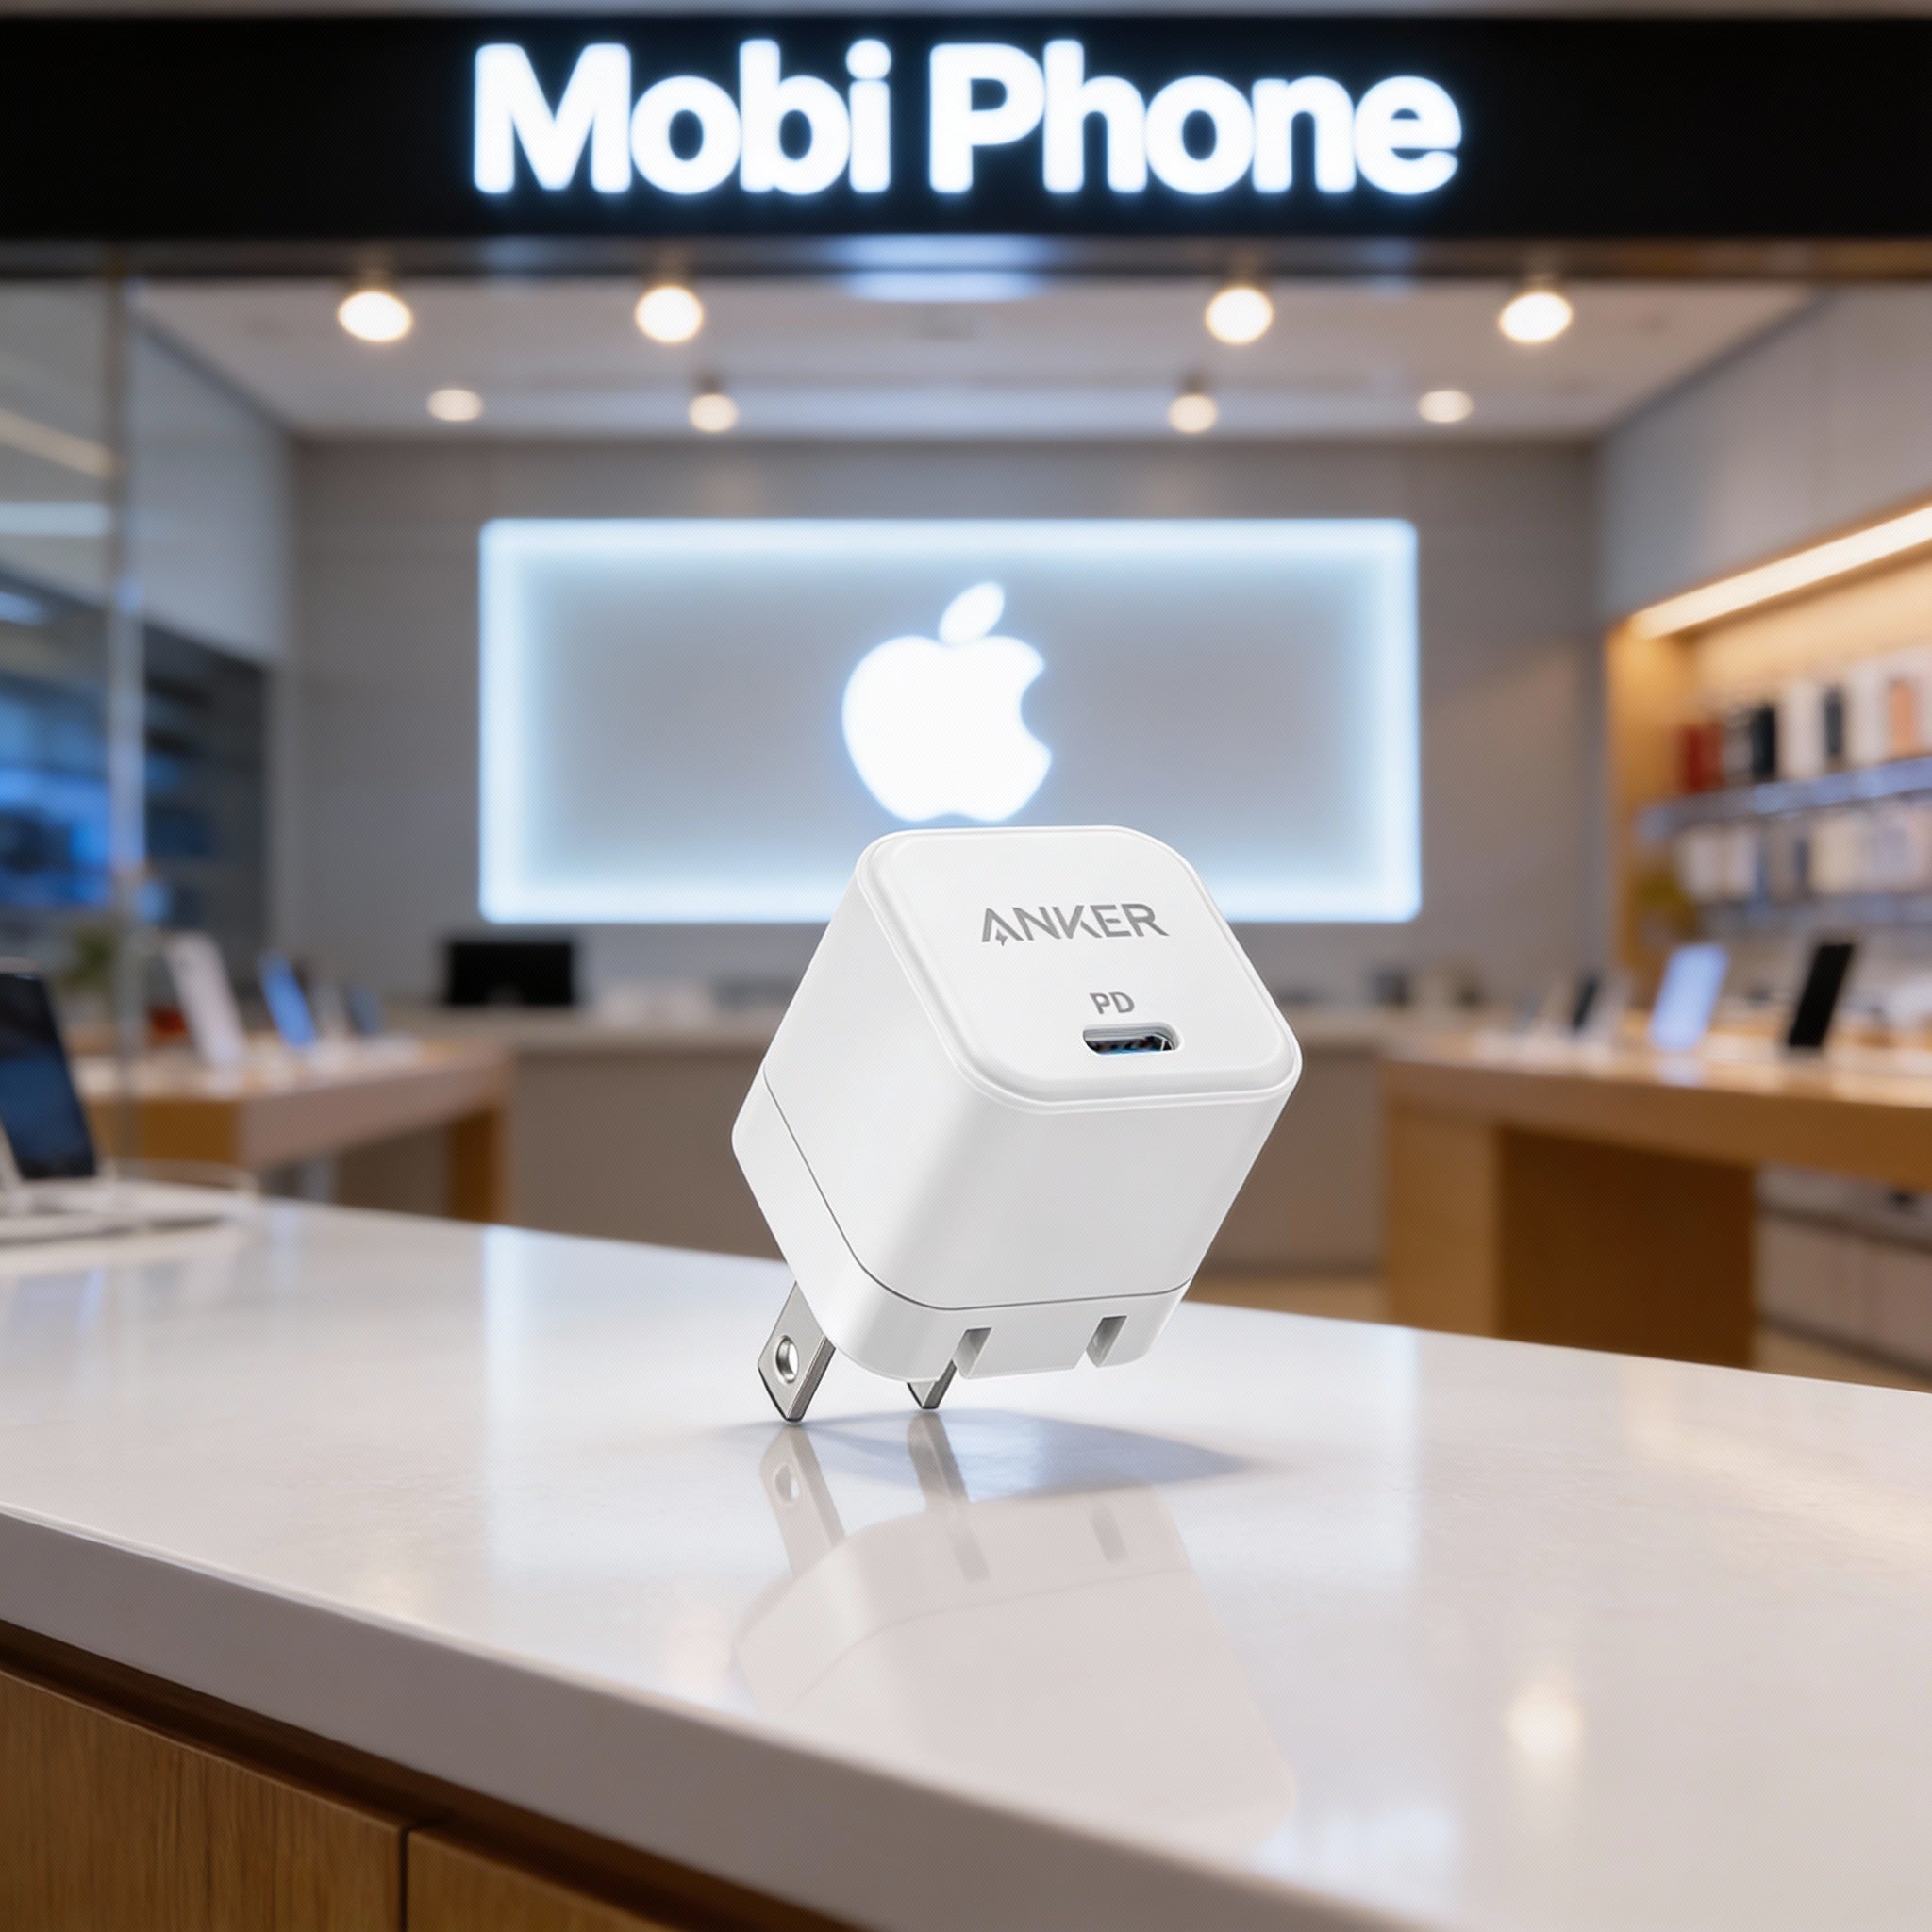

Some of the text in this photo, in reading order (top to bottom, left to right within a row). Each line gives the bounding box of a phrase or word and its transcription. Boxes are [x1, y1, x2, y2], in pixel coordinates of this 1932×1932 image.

[474, 39, 1462, 195] Mobi Phone
[981, 903, 1170, 946] ANKER
[1089, 991, 1135, 1015] PD
